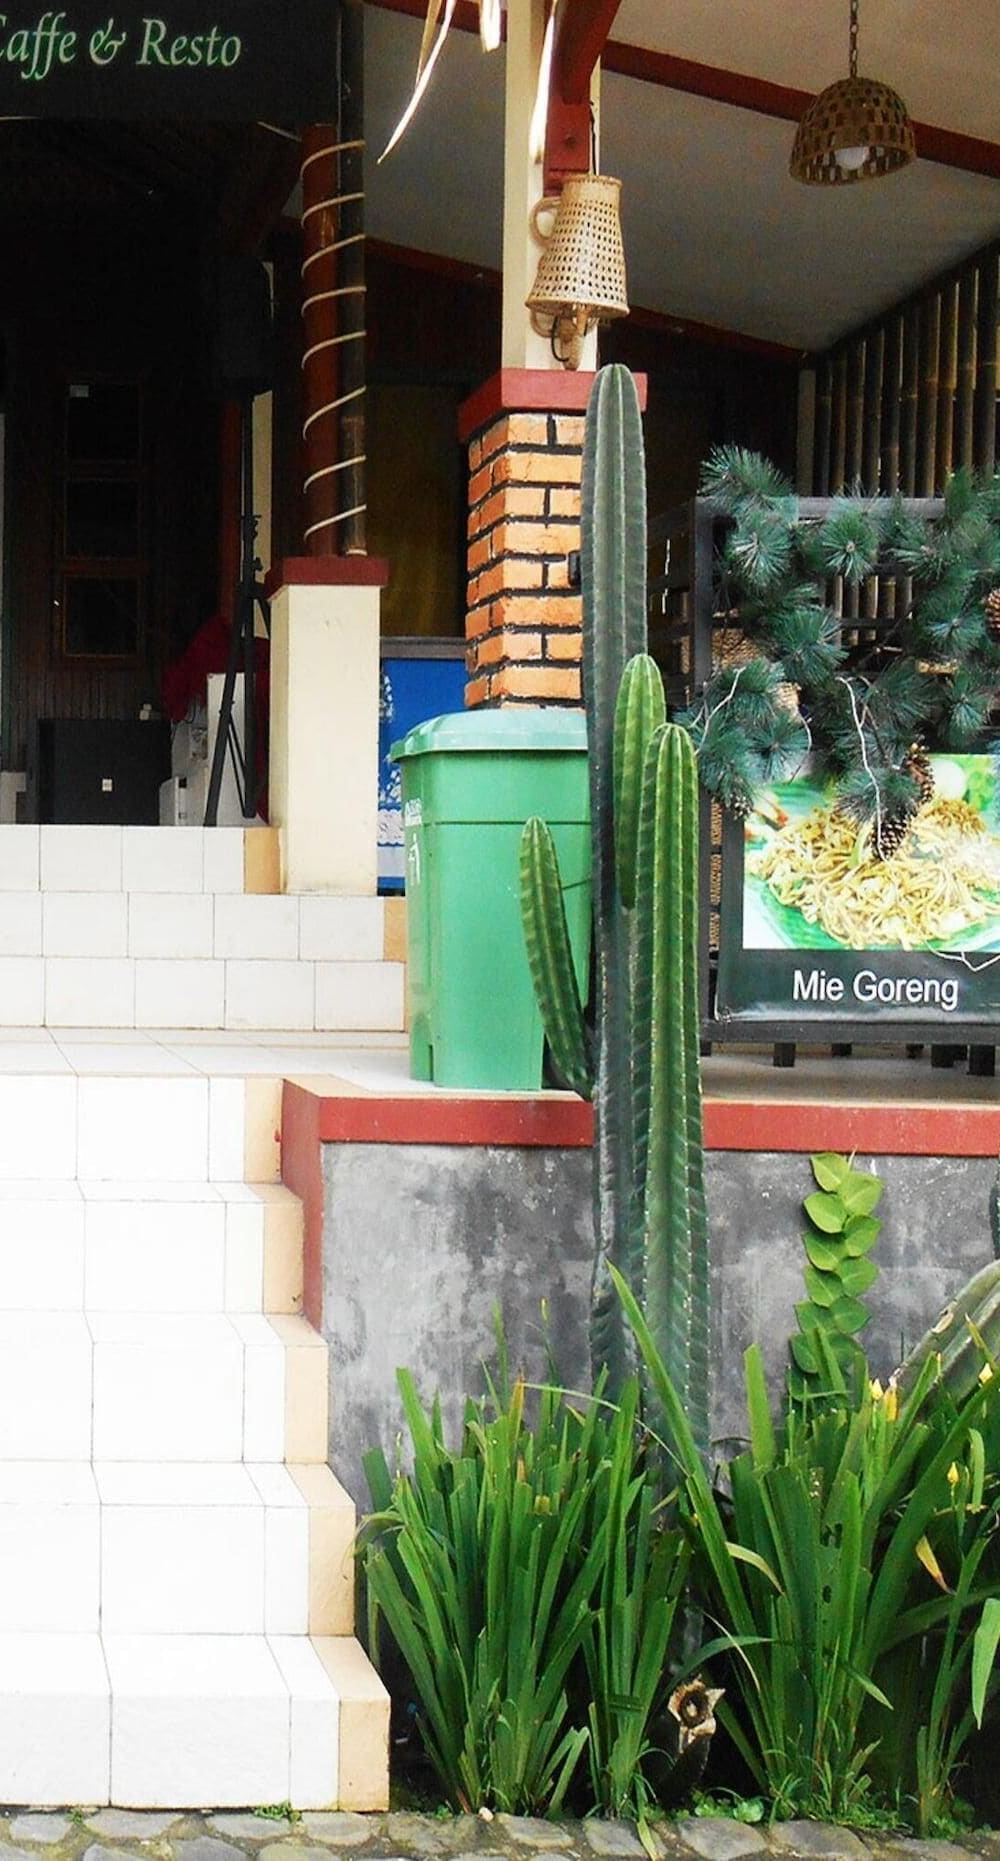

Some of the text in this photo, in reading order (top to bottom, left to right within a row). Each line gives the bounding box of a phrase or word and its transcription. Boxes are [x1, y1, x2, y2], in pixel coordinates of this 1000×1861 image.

[89, 17, 127, 66] &
[136, 18, 242, 67] Resto
[793, 969, 960, 1011] Mie Goreng
